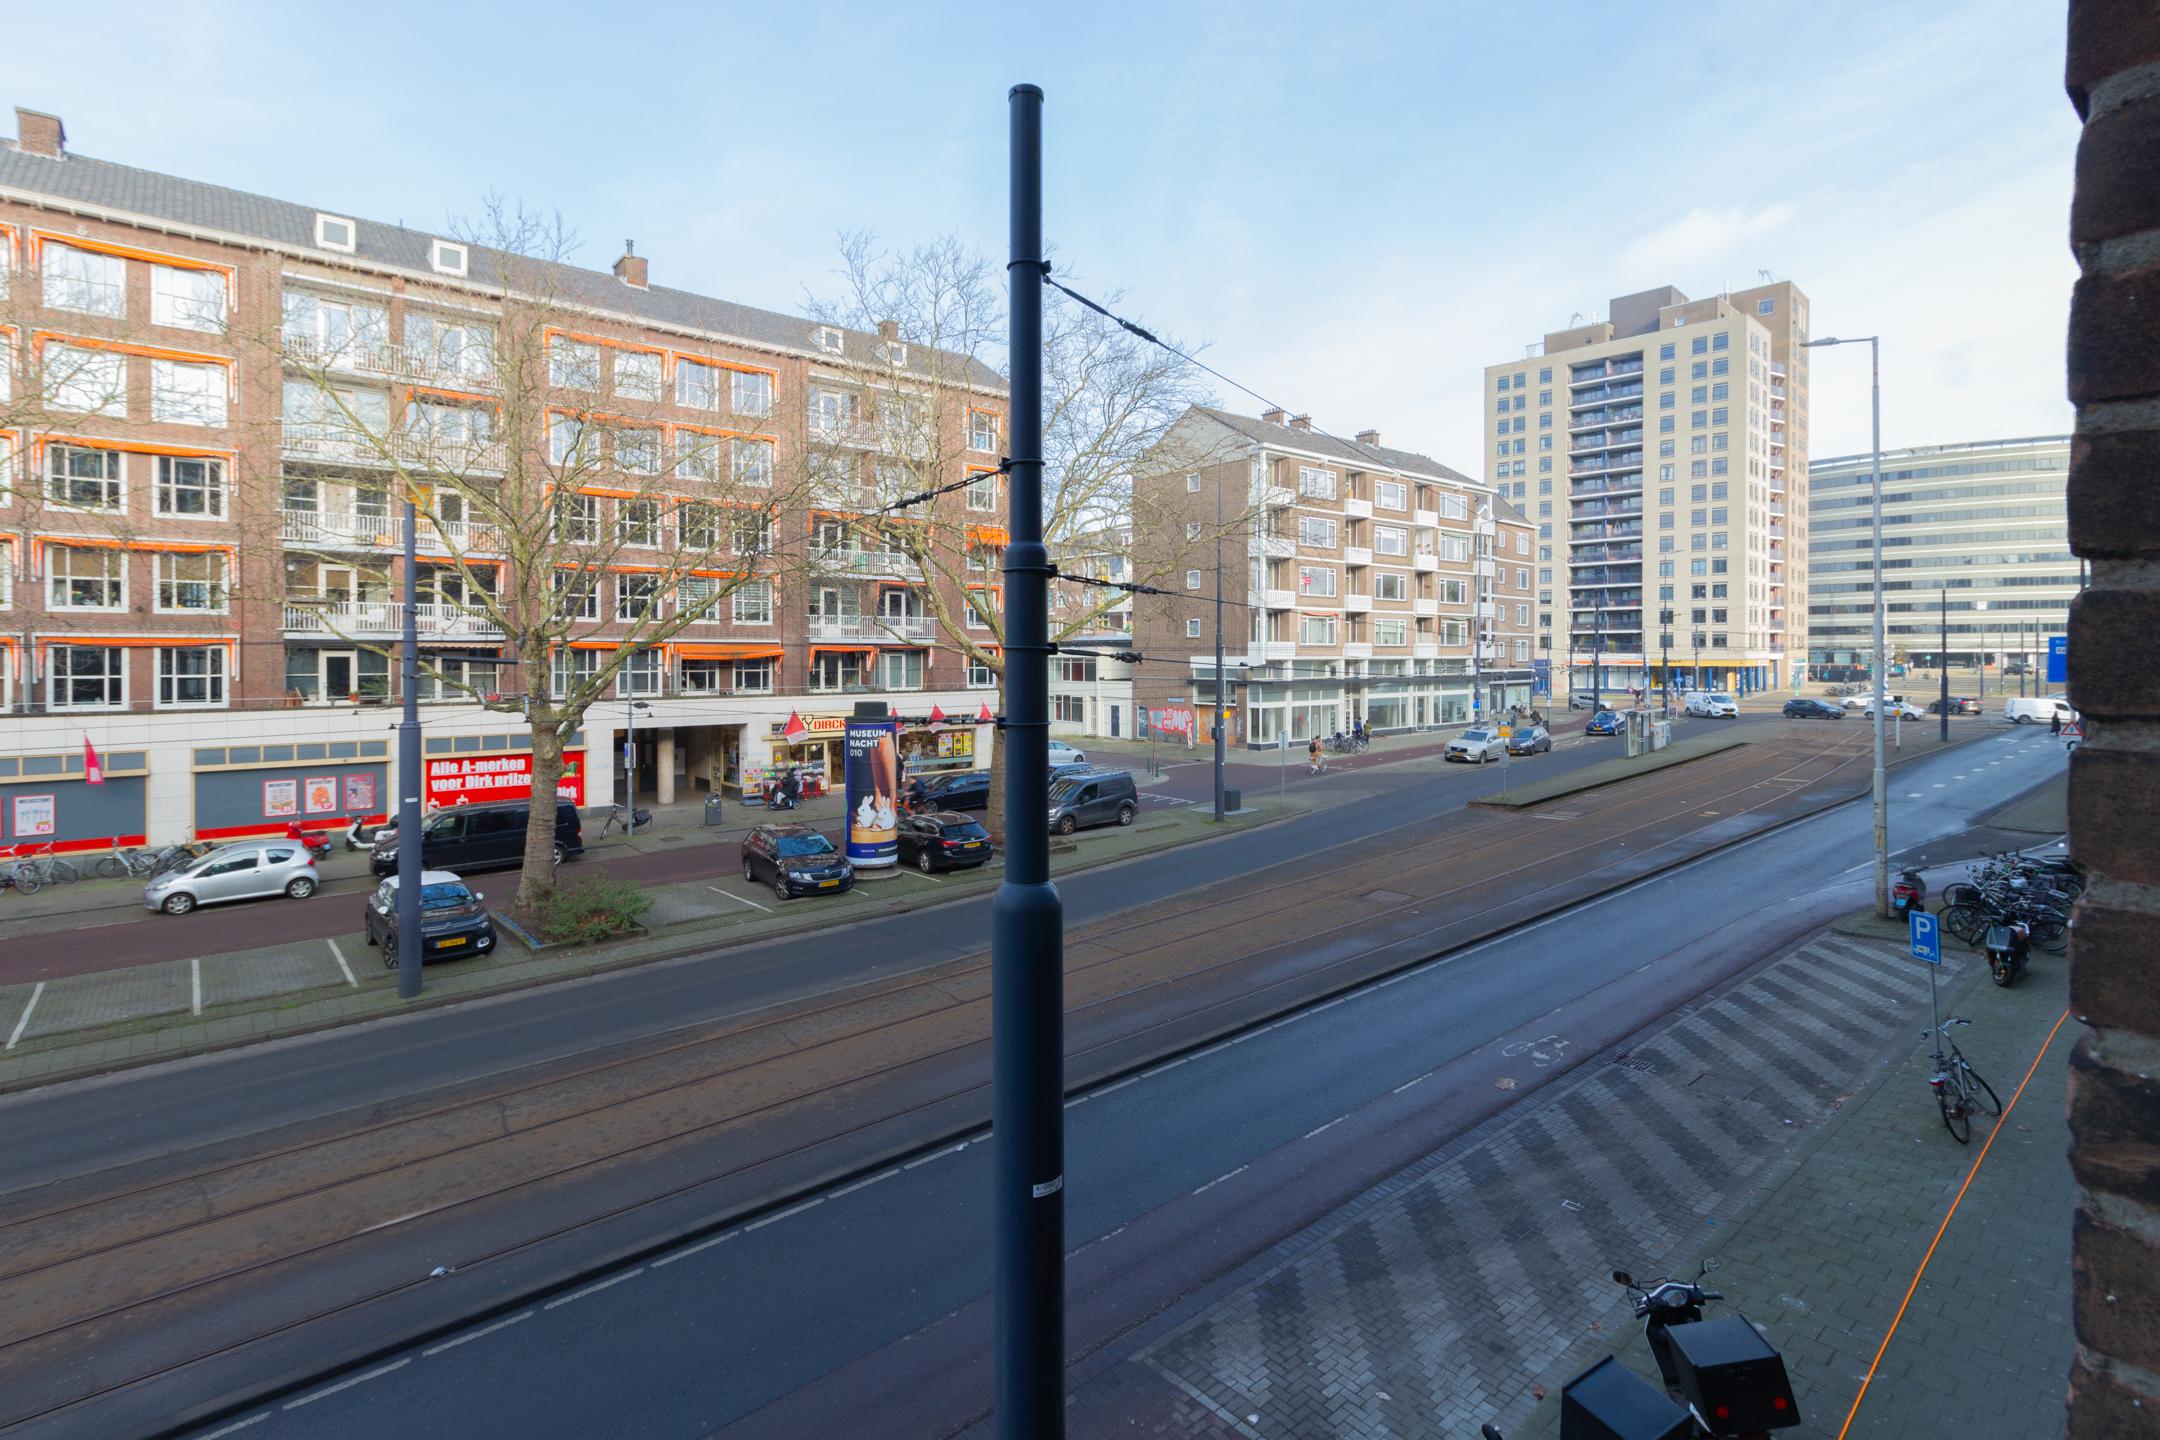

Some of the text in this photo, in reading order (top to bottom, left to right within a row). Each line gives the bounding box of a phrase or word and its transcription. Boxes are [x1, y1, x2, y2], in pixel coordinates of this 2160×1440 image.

[850, 729, 886, 738] MUSEUM
[850, 739, 879, 748] NACHT
[850, 749, 863, 757] 010
[431, 759, 526, 776] Alle A-merken
[431, 772, 532, 792] voor Dirk prijze
[1915, 916, 1931, 939] P
